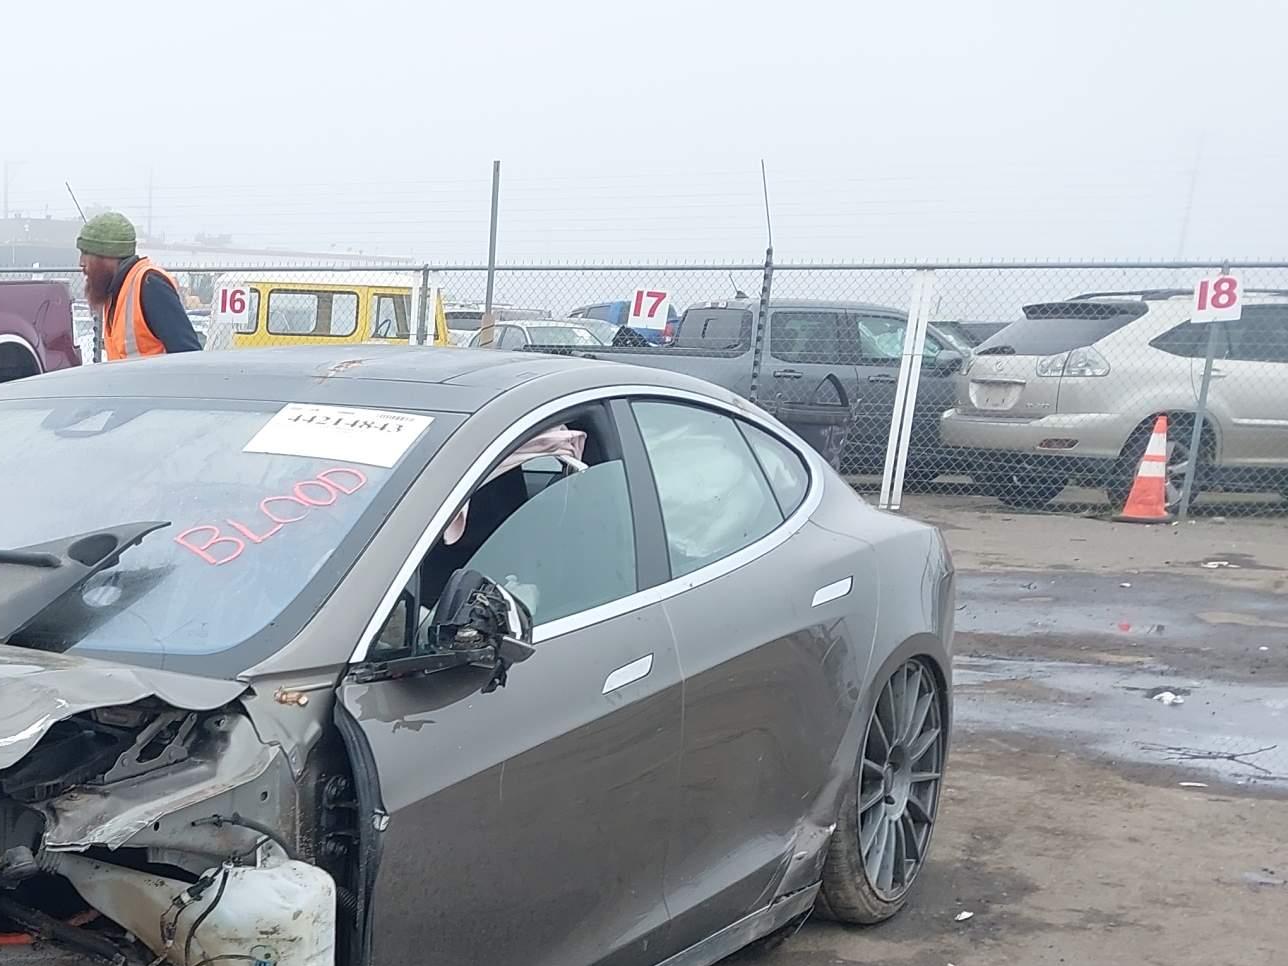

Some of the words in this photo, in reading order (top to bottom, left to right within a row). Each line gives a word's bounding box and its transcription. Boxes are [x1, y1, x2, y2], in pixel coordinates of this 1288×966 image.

[220, 288, 246, 314] 16
[632, 290, 667, 318] 17
[1198, 277, 1238, 310] 18
[287, 413, 404, 433] 44214843
[174, 467, 368, 566] BLOOD
